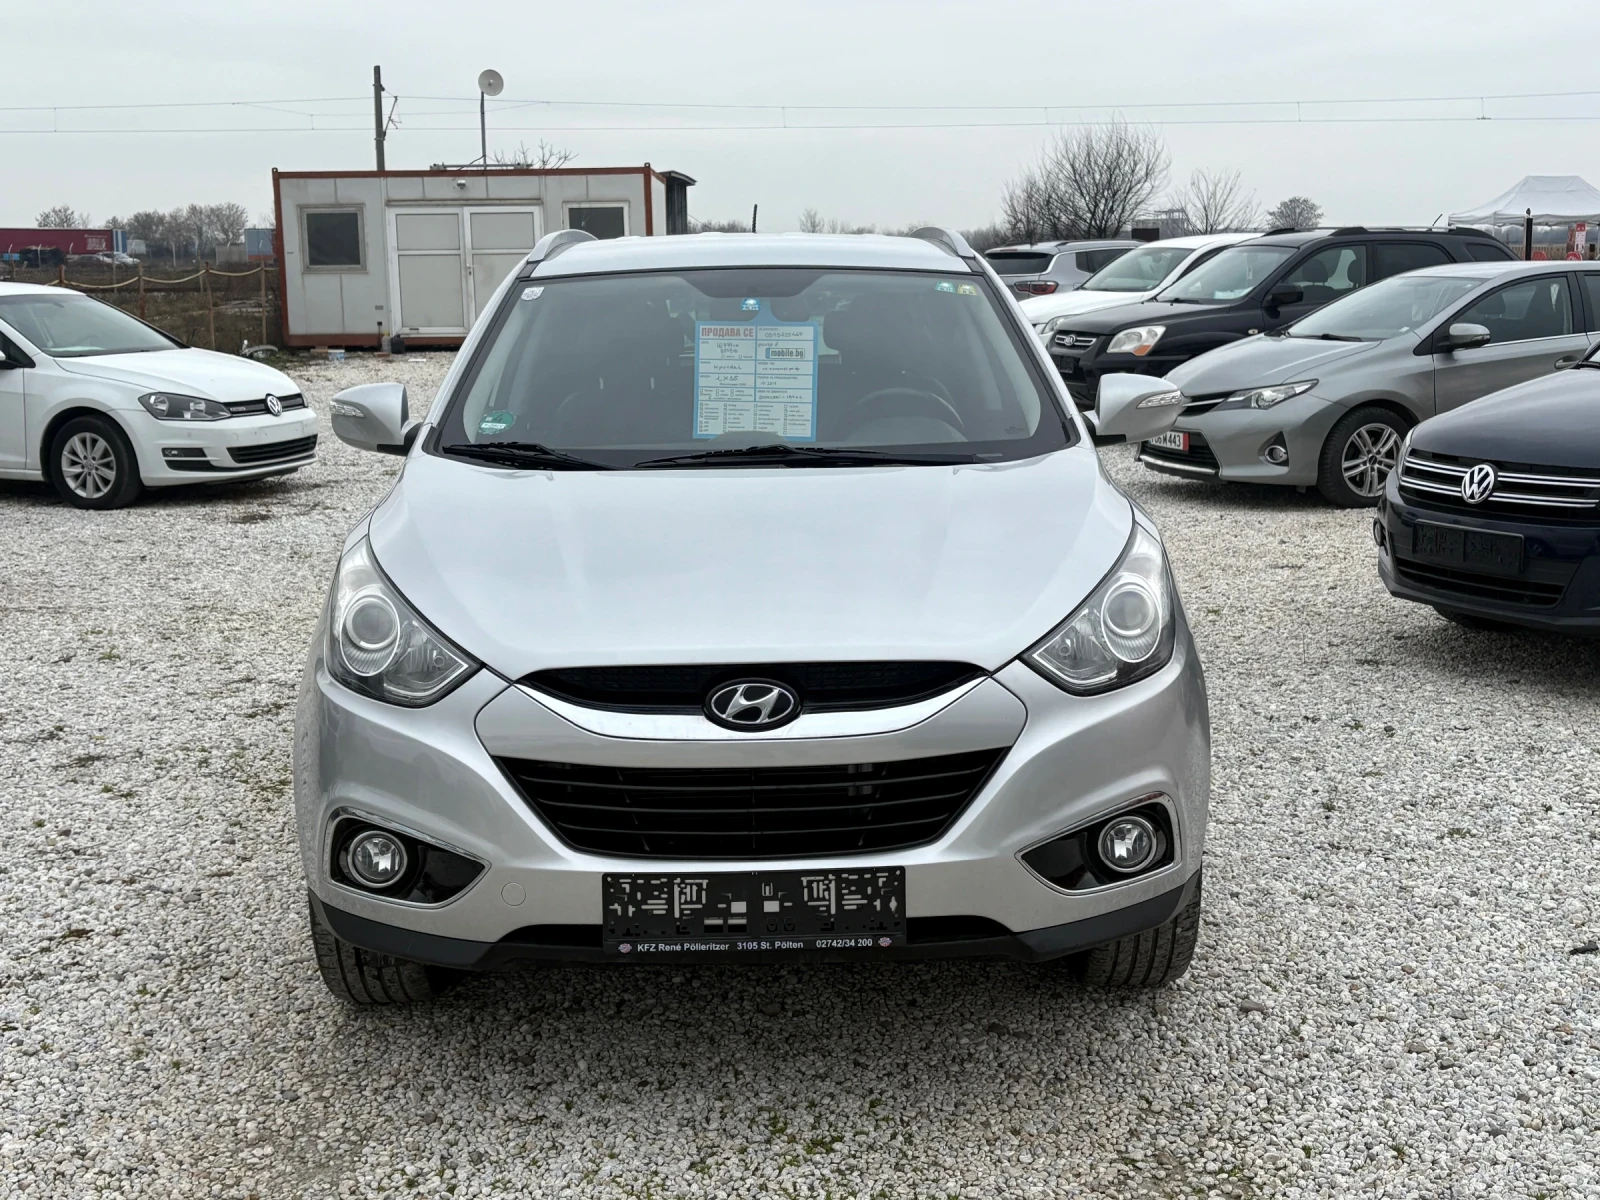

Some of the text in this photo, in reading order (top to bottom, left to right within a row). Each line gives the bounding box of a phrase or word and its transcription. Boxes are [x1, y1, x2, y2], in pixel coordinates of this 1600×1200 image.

[701, 327, 754, 338] ПРОДАВА СЕ
[770, 348, 804, 359] mobile.bg
[637, 943, 657, 952] KFZ
[658, 942, 682, 951] René
[684, 942, 730, 951] Pölleritzer
[736, 941, 758, 950] 3105
[760, 941, 773, 949] St.
[774, 940, 803, 949] Pölten
[816, 939, 855, 948] 02742/34
[857, 938, 873, 947] 200
